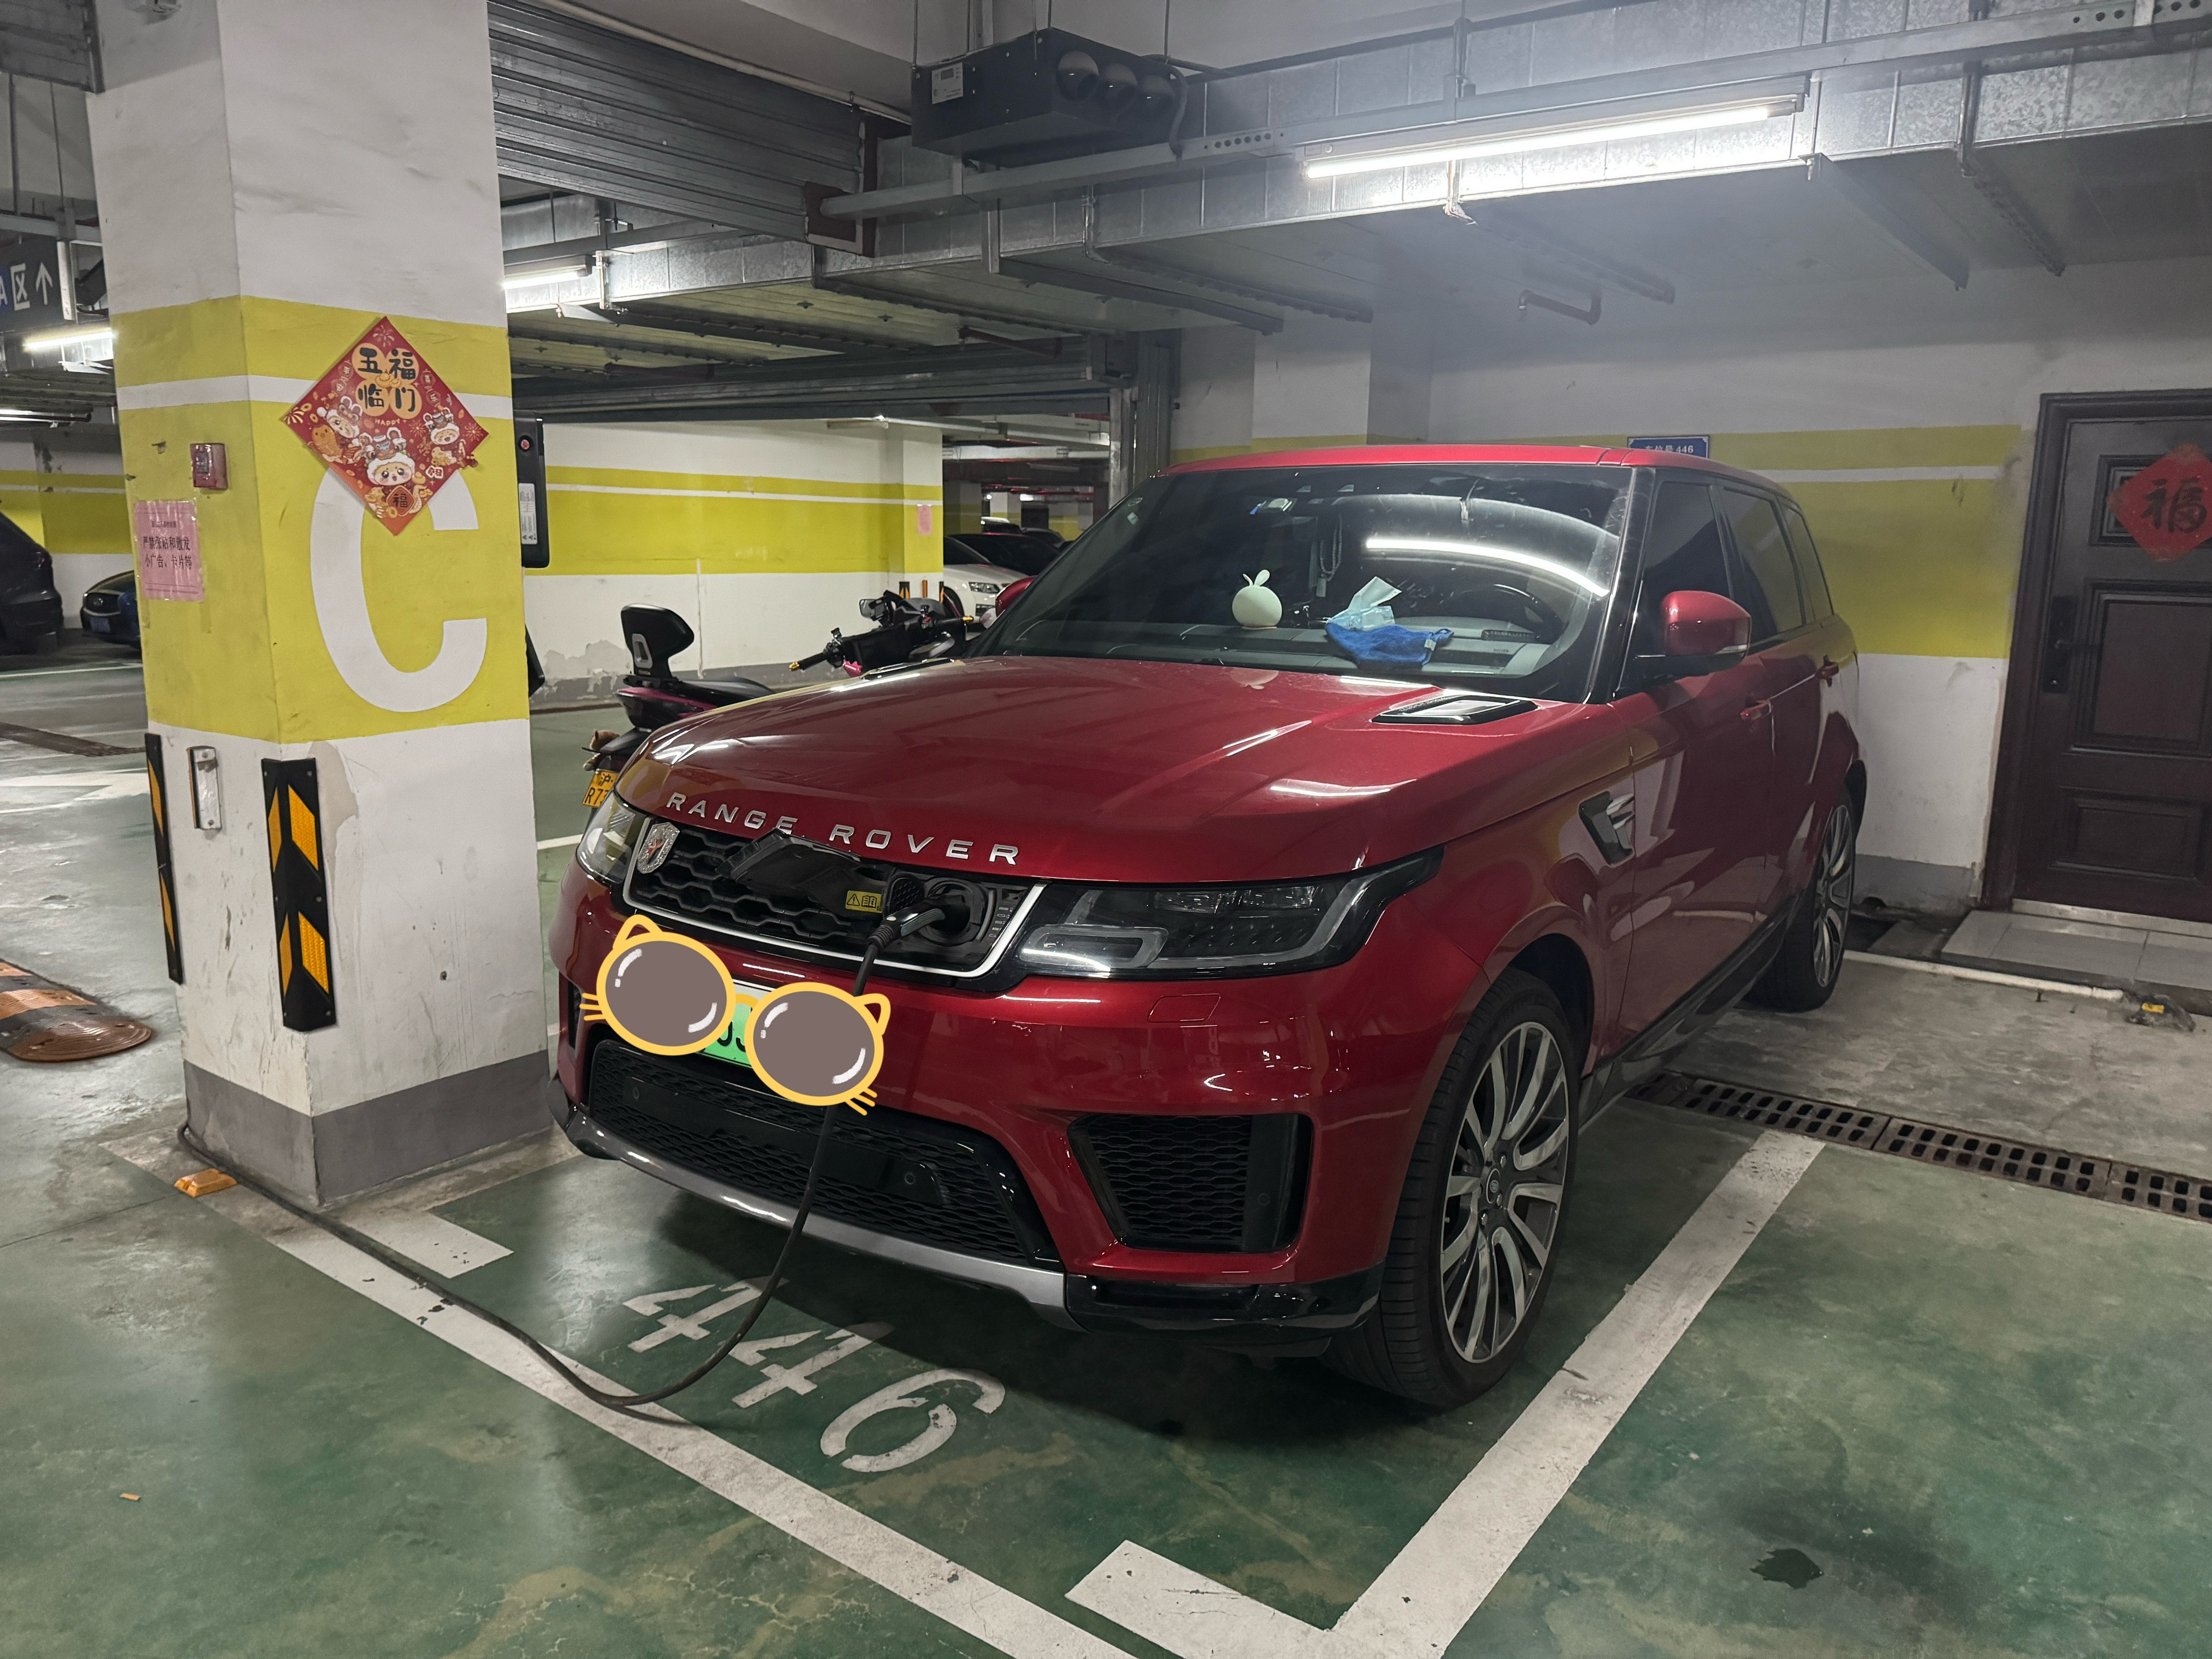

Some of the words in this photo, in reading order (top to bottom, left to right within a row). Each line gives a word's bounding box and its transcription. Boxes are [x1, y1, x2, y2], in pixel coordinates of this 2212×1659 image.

[358, 347, 415, 381] 五福
[358, 383, 415, 412] 临门
[374, 418, 401, 427] HAPPY
[393, 493, 408, 509] 福
[2141, 476, 2208, 534] 福
[310, 469, 487, 712] C
[666, 792, 798, 834] RANGE
[828, 824, 1020, 865] ROVER
[623, 1276, 1006, 1473] 446
